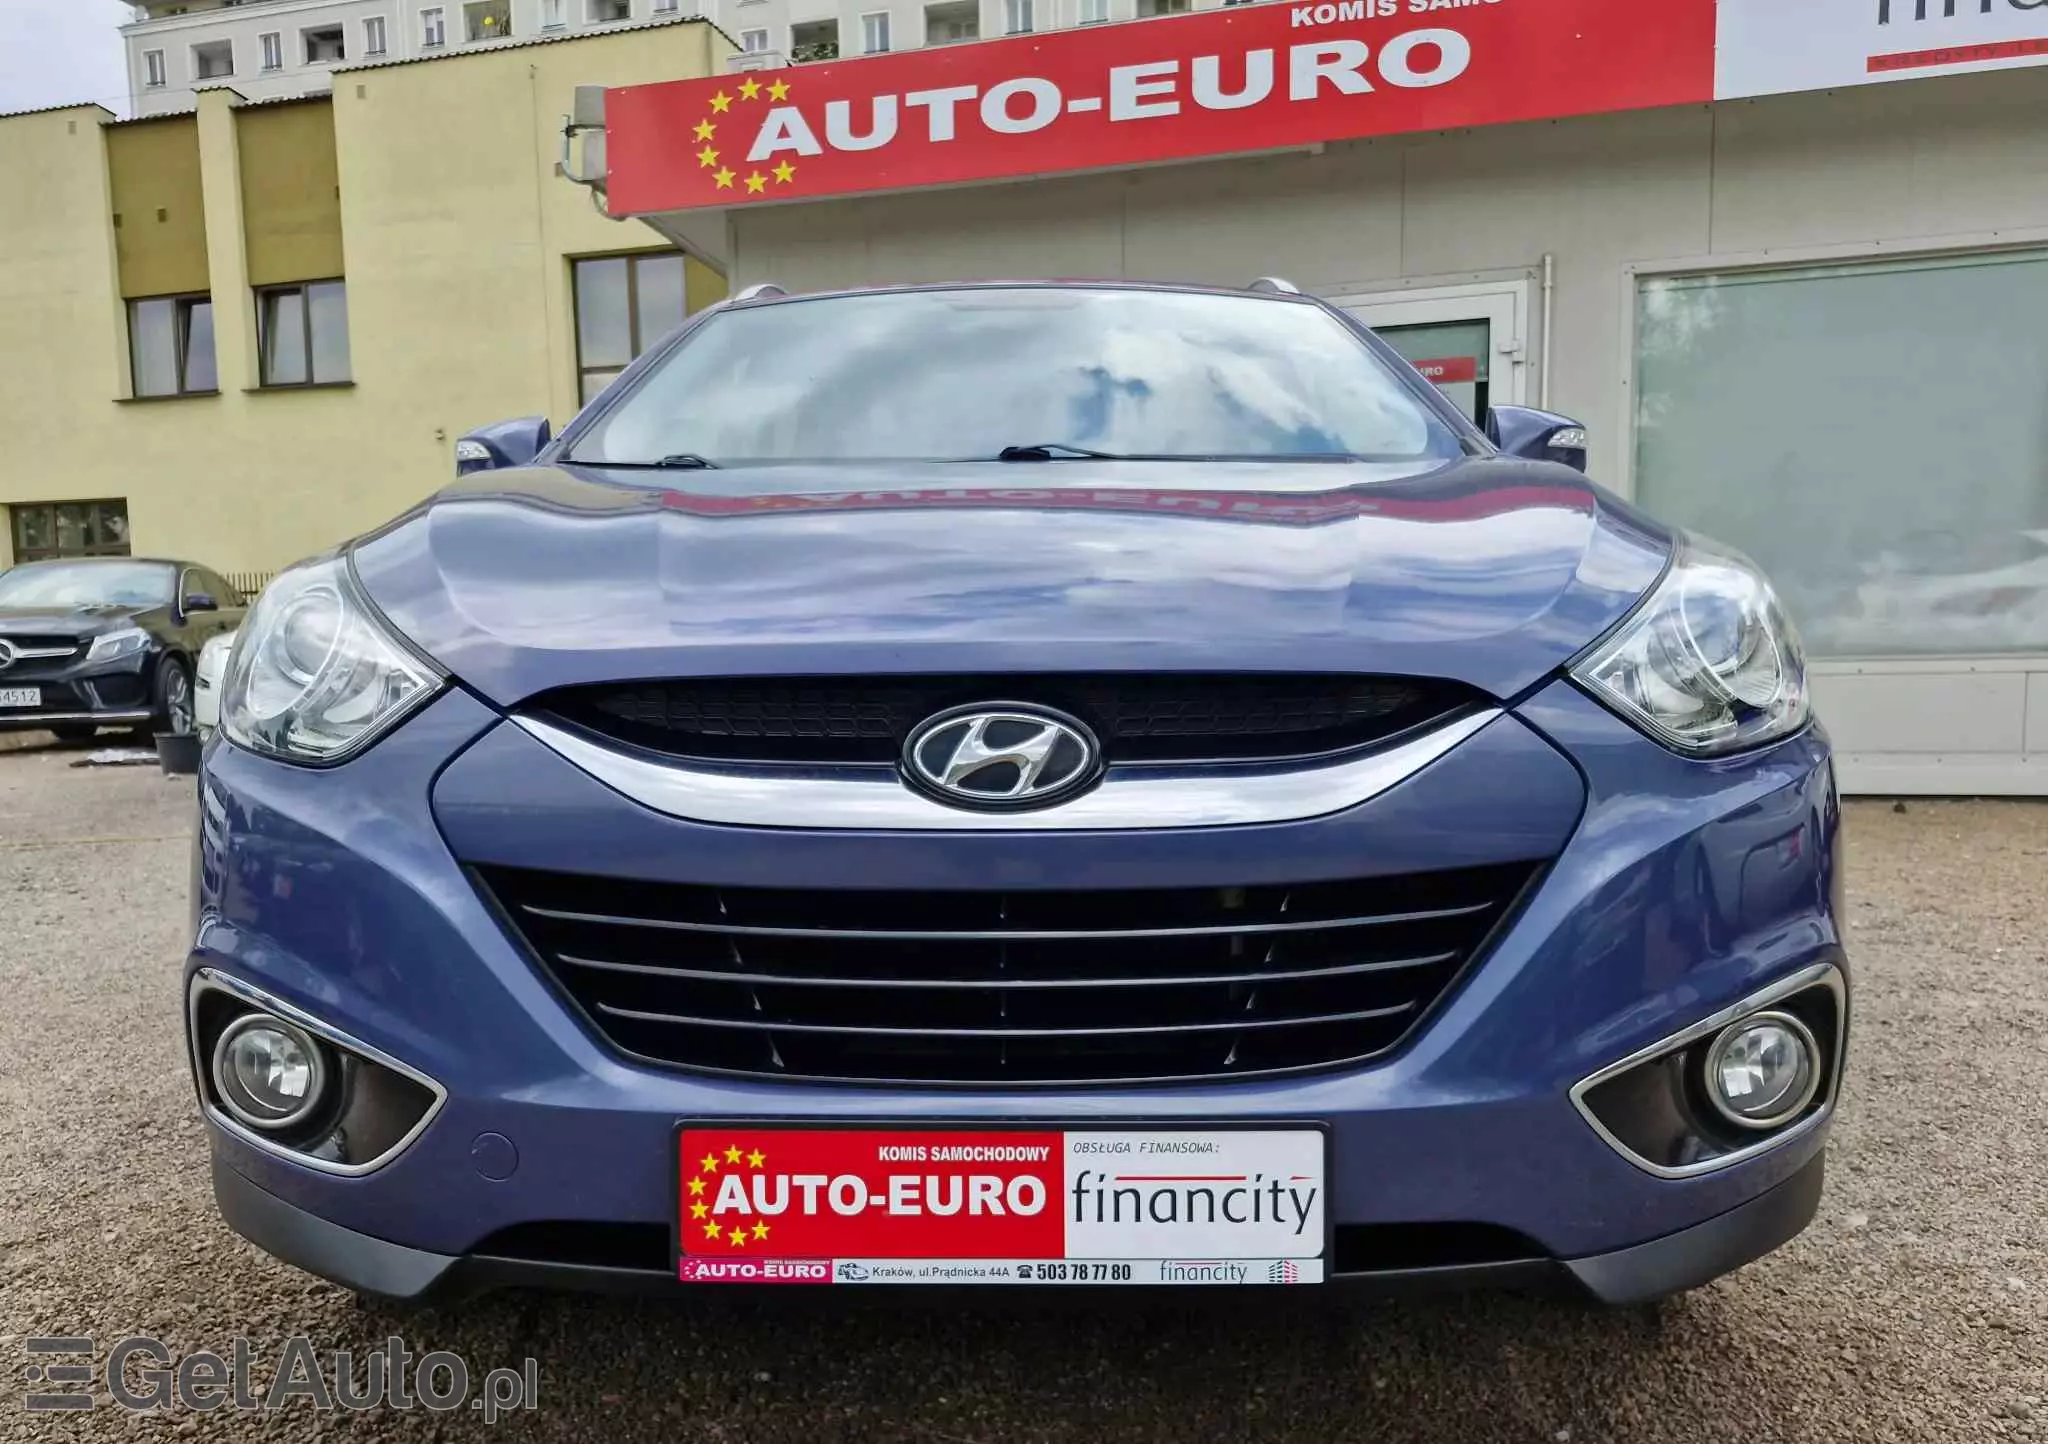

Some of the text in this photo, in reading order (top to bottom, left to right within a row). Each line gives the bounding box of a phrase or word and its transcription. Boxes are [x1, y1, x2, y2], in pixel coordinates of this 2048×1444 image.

[1291, 0, 1398, 27] KOMIS
[746, 28, 1472, 162] AUTO-EURO
[0, 690, 36, 703] 4512
[878, 1146, 1050, 1162] KOMIS SAMOCHODOWY
[1073, 1142, 1220, 1153] OBSŁUGA FINANSOWA:
[712, 1174, 1046, 1217] AUTO-EURO
[695, 1263, 826, 1278] AUTO-EURO
[872, 1266, 916, 1279] Kraków,
[988, 1267, 1010, 1277] 44A
[1036, 1263, 1131, 1281] 503 78 77 80
[1160, 1261, 1248, 1284] financity
